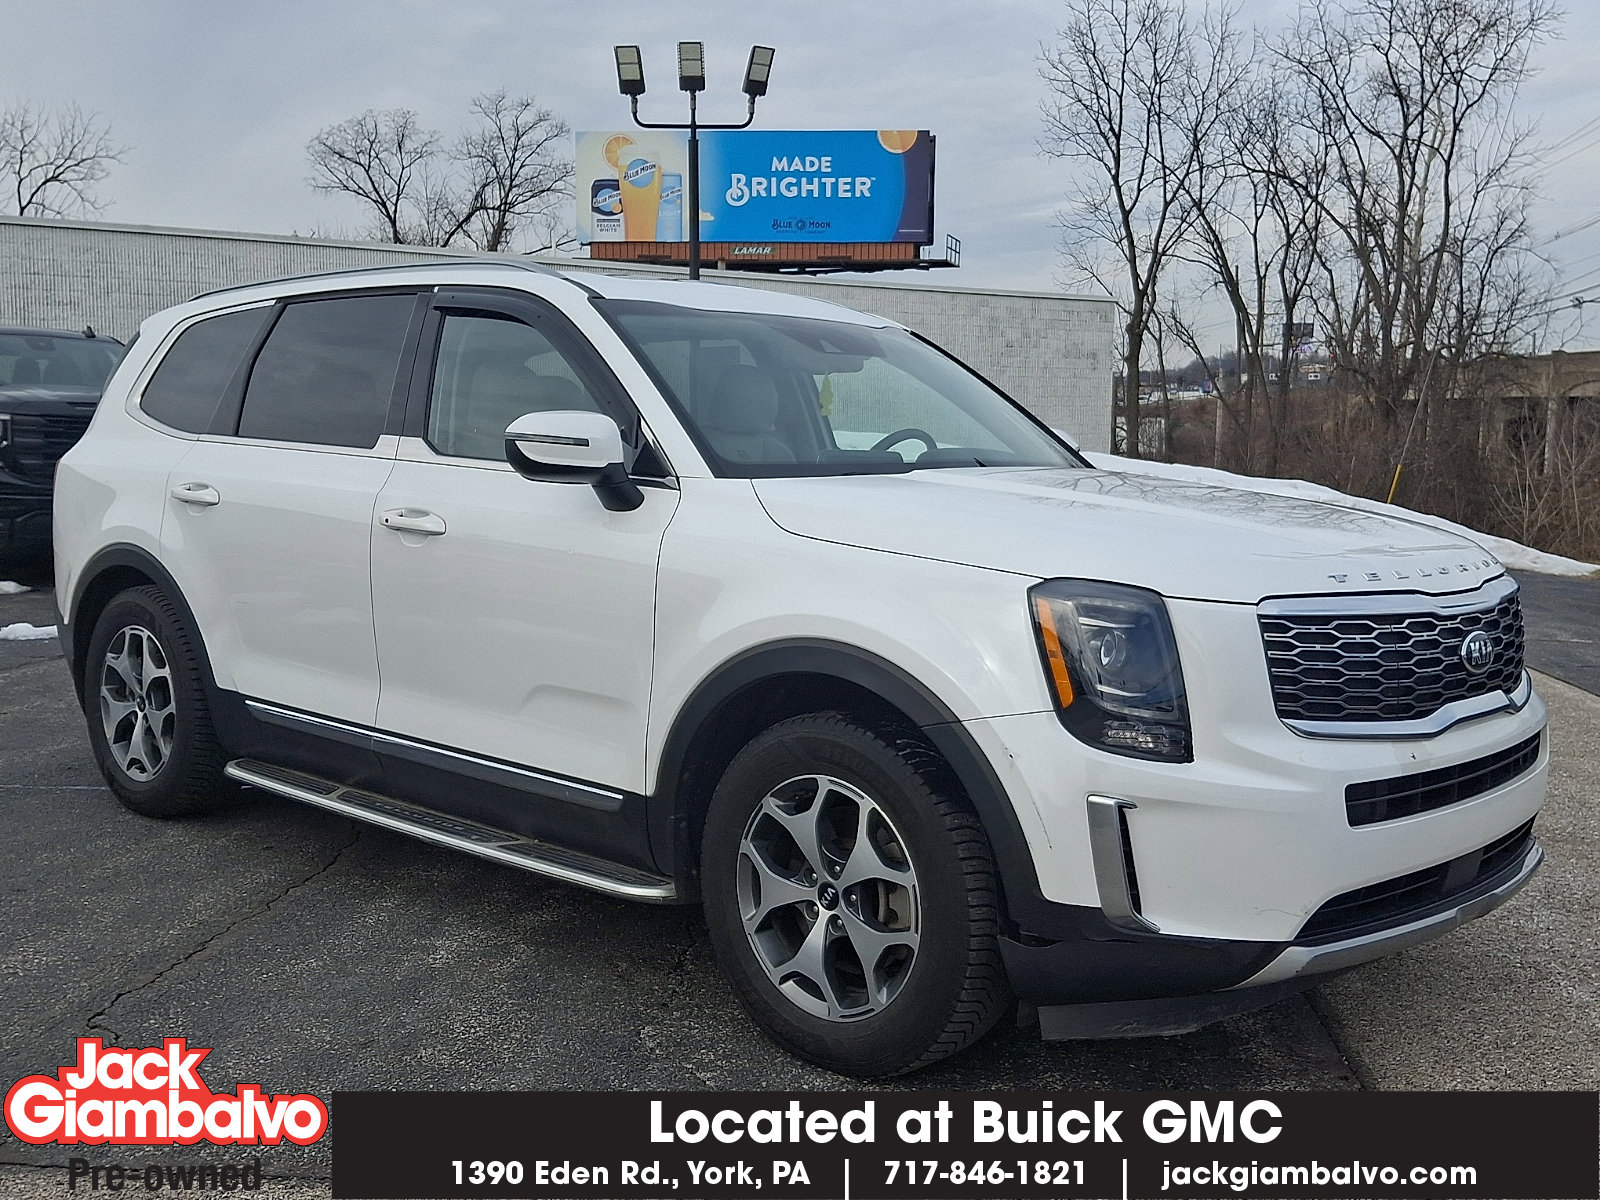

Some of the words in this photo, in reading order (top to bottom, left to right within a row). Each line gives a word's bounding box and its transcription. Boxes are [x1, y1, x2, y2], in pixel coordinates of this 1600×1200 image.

[623, 169, 639, 181] BLUE
[640, 163, 656, 174] MOON
[771, 156, 832, 172] MADE
[771, 218, 793, 230] BLUE
[808, 221, 831, 229] MOON
[733, 246, 772, 254] LAMAR
[1469, 640, 1493, 666] KIA
[820, 887, 836, 908] KIA
